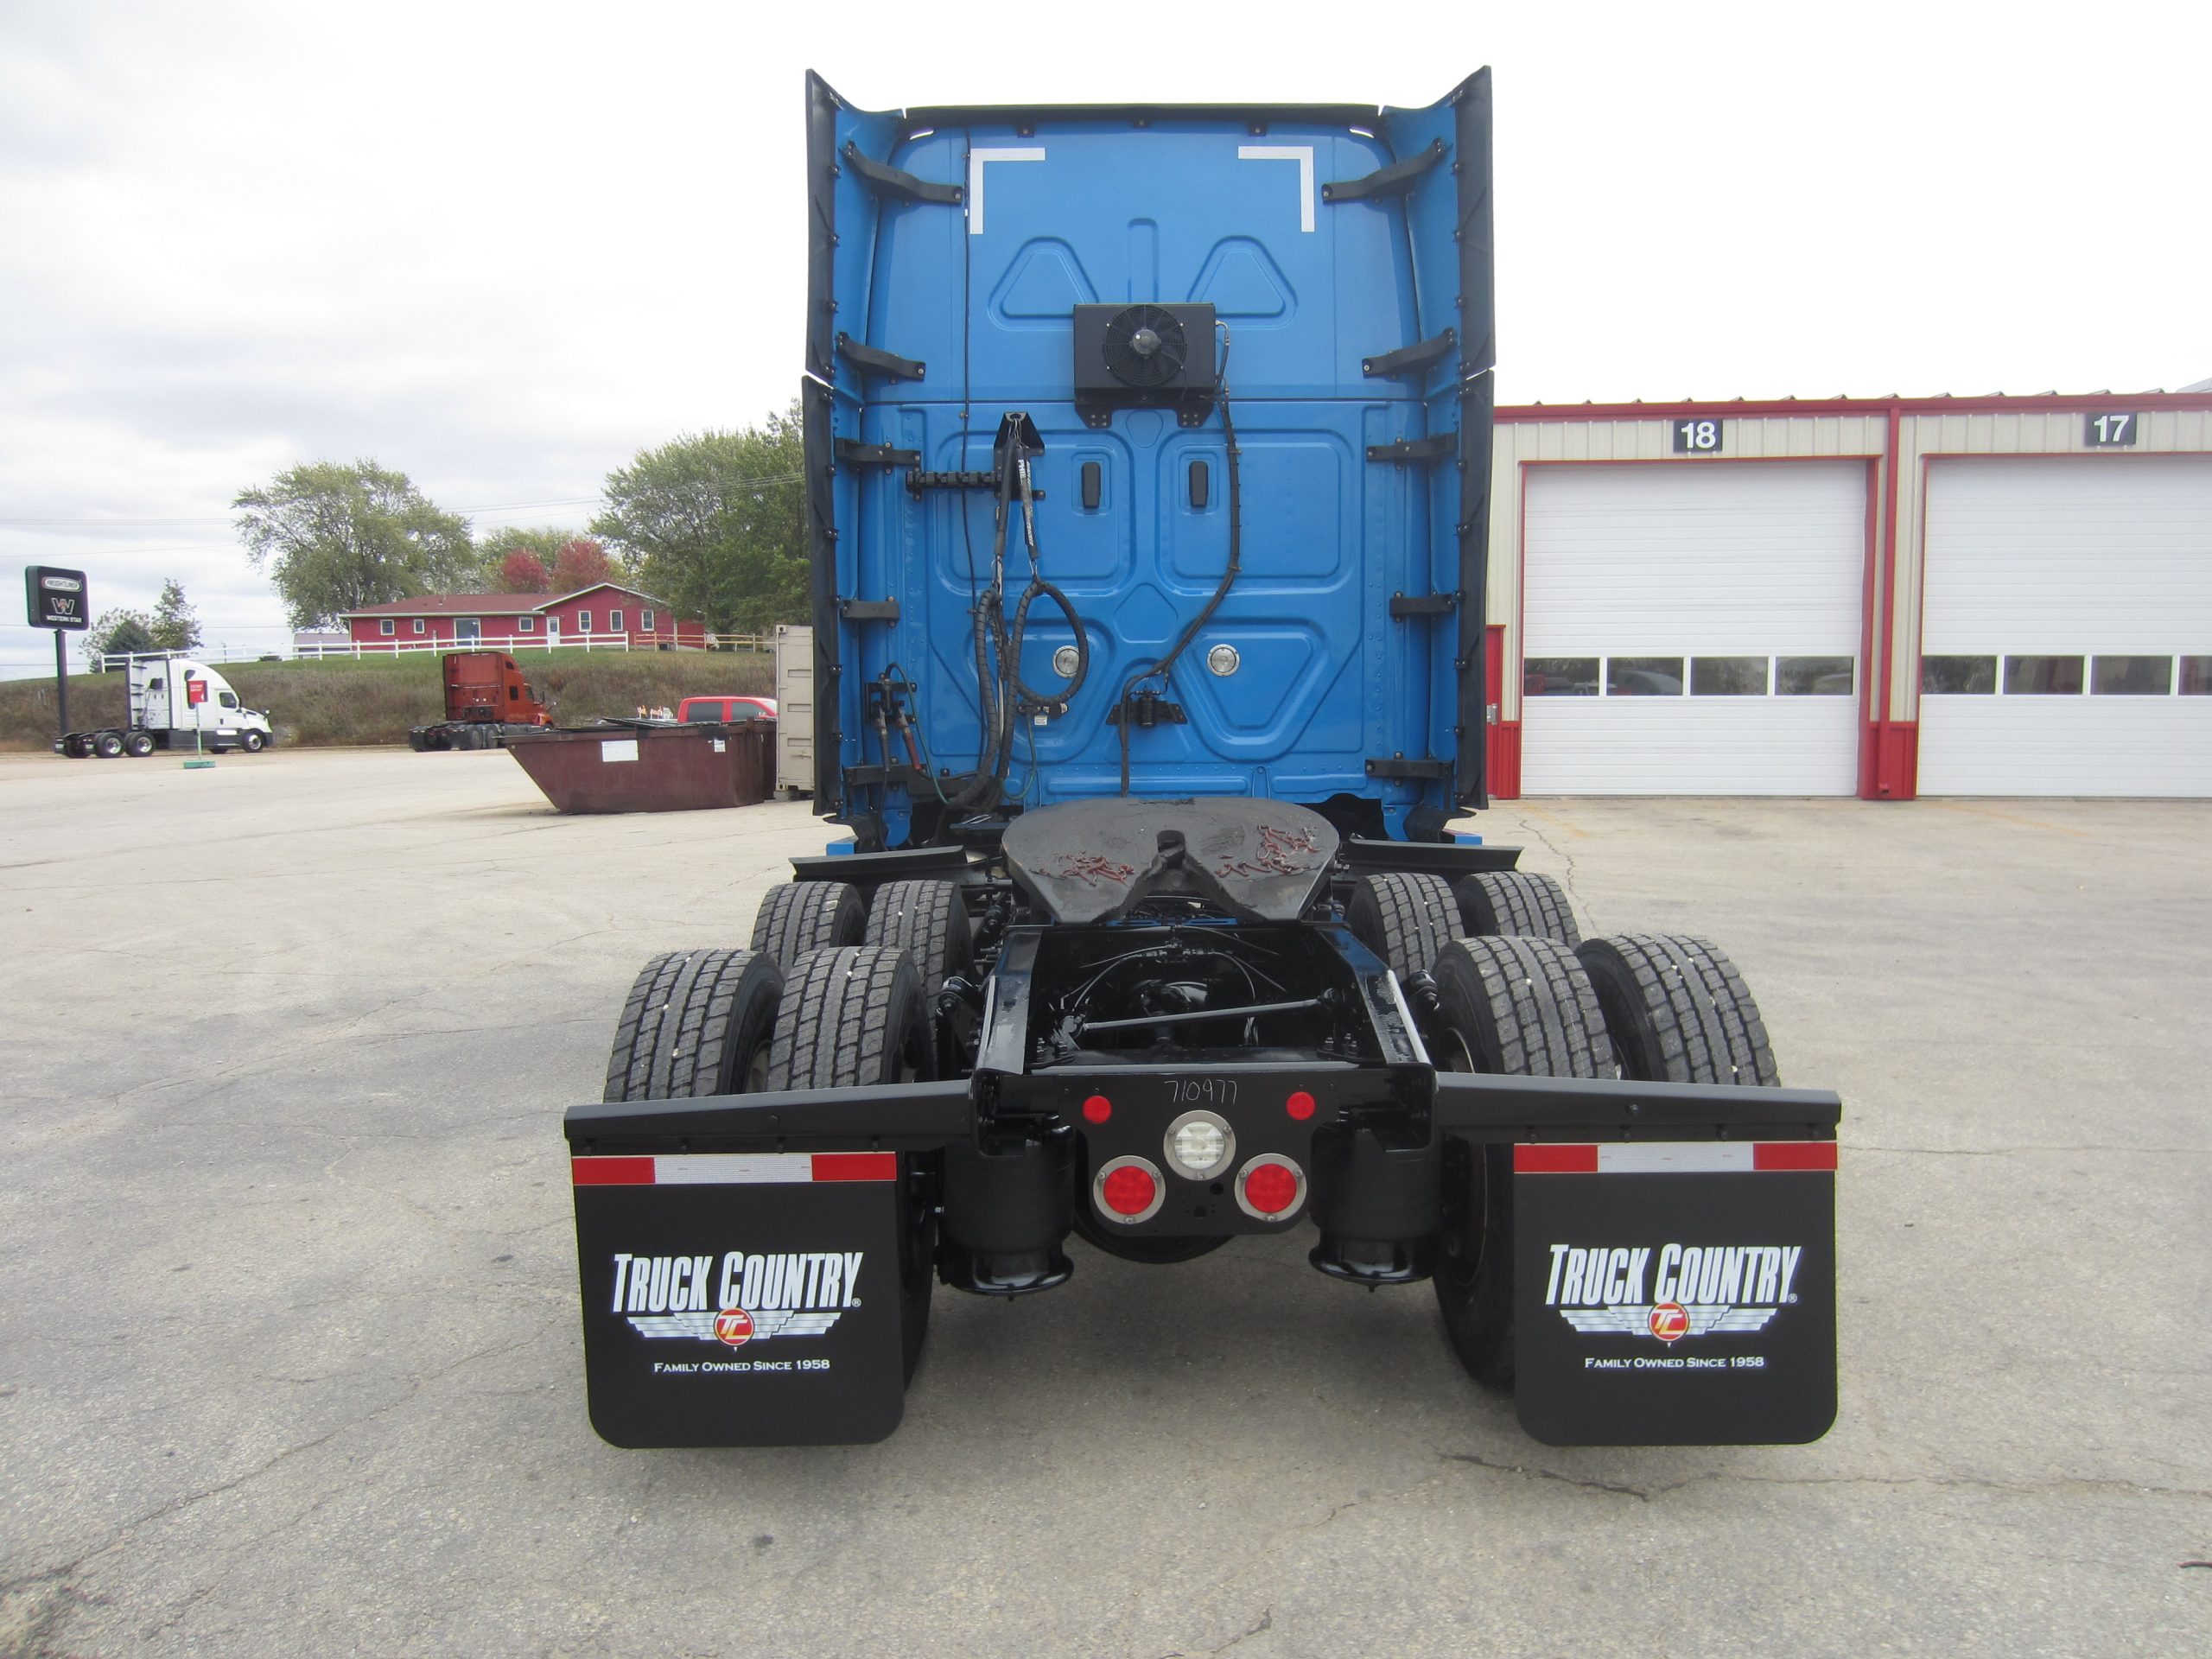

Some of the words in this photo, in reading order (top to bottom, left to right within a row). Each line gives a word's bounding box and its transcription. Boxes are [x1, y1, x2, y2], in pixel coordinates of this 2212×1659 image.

[1681, 421, 1716, 449] 18
[2094, 415, 2130, 442] 17
[1164, 1077, 1237, 1105] 710977
[613, 1253, 713, 1313] TRUCK
[718, 1251, 864, 1310] COUNTRY
[1545, 1244, 1651, 1306] TRUCK
[1654, 1243, 1802, 1305] COUNTRY
[654, 1362, 700, 1373] FAMILY
[702, 1362, 751, 1372] OWNED
[753, 1360, 792, 1371] SINCE
[796, 1359, 830, 1370] 1958
[1585, 1357, 1632, 1369] FAMILY
[1633, 1357, 1685, 1368] OWNED
[1686, 1357, 1726, 1368] SINCE
[1730, 1357, 1764, 1368] 1958
